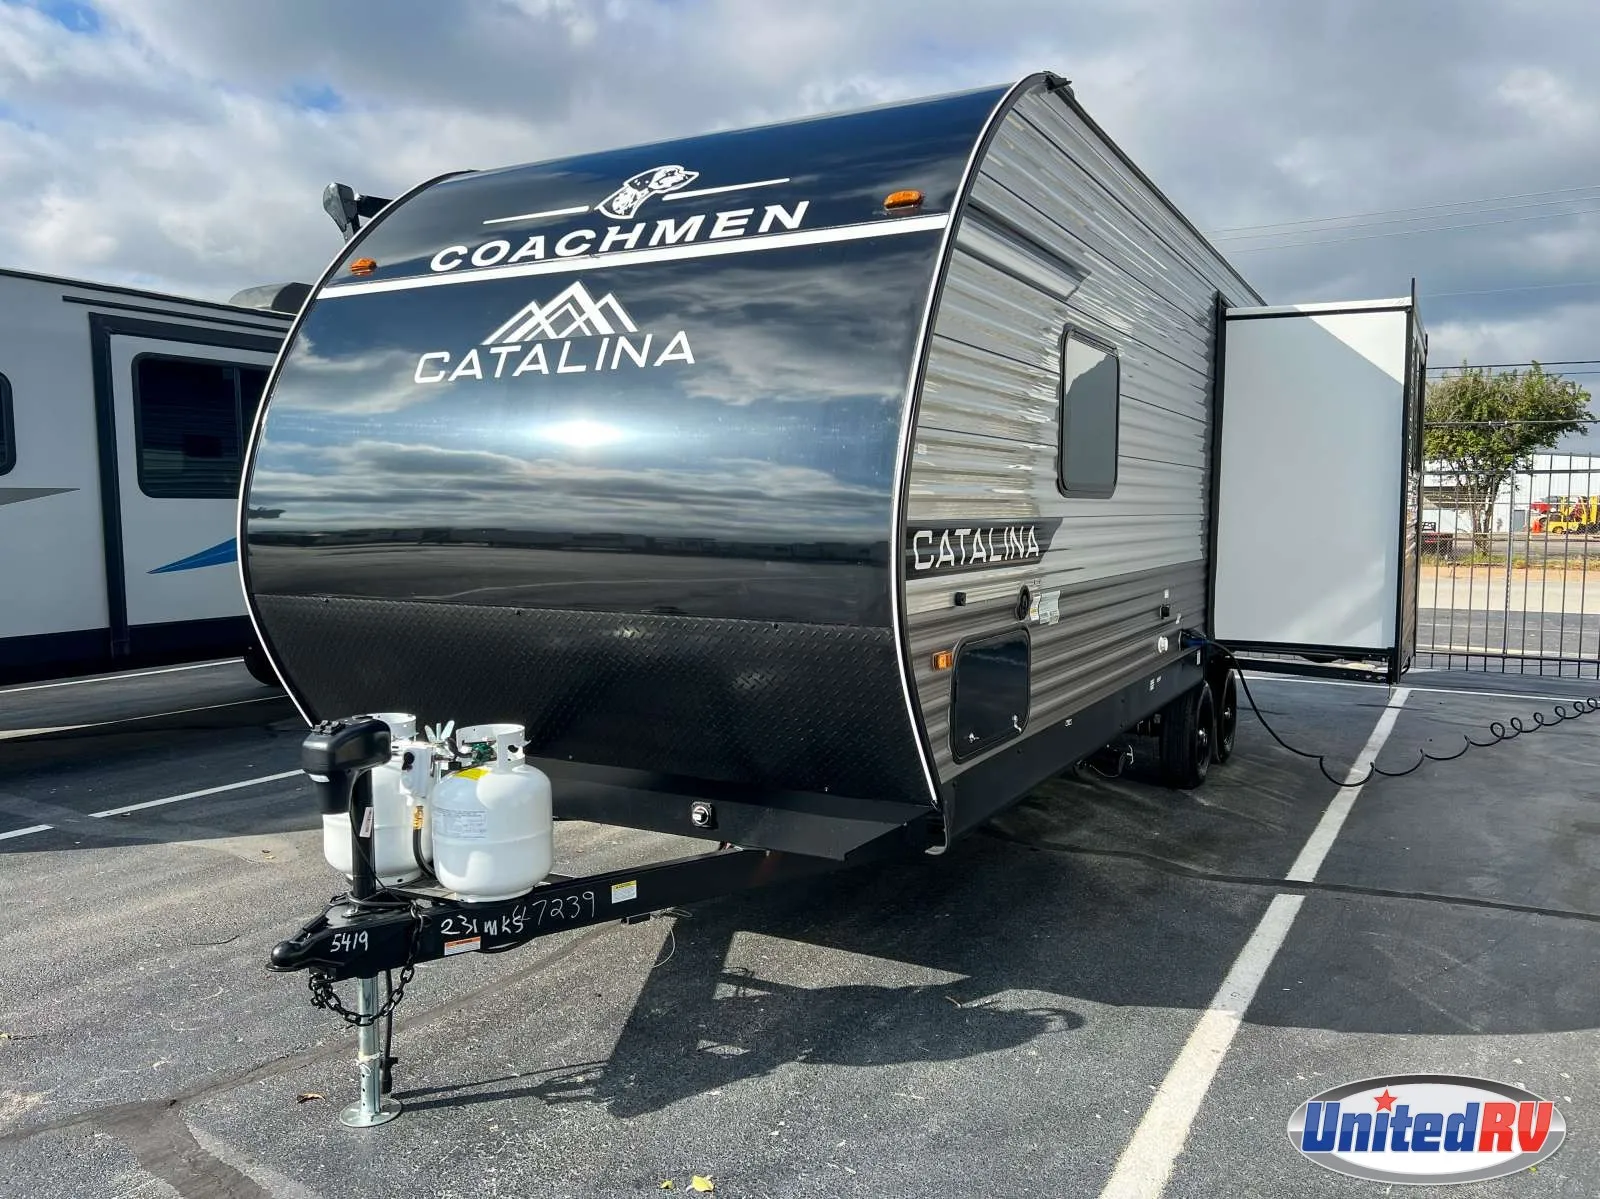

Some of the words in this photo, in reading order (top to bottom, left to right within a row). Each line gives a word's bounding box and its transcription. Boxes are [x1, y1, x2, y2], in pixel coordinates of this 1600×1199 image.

[429, 200, 811, 273] COACHMEN
[413, 330, 696, 385] CATALINA
[912, 525, 1040, 571] CATALINA
[329, 930, 369, 953] 5419
